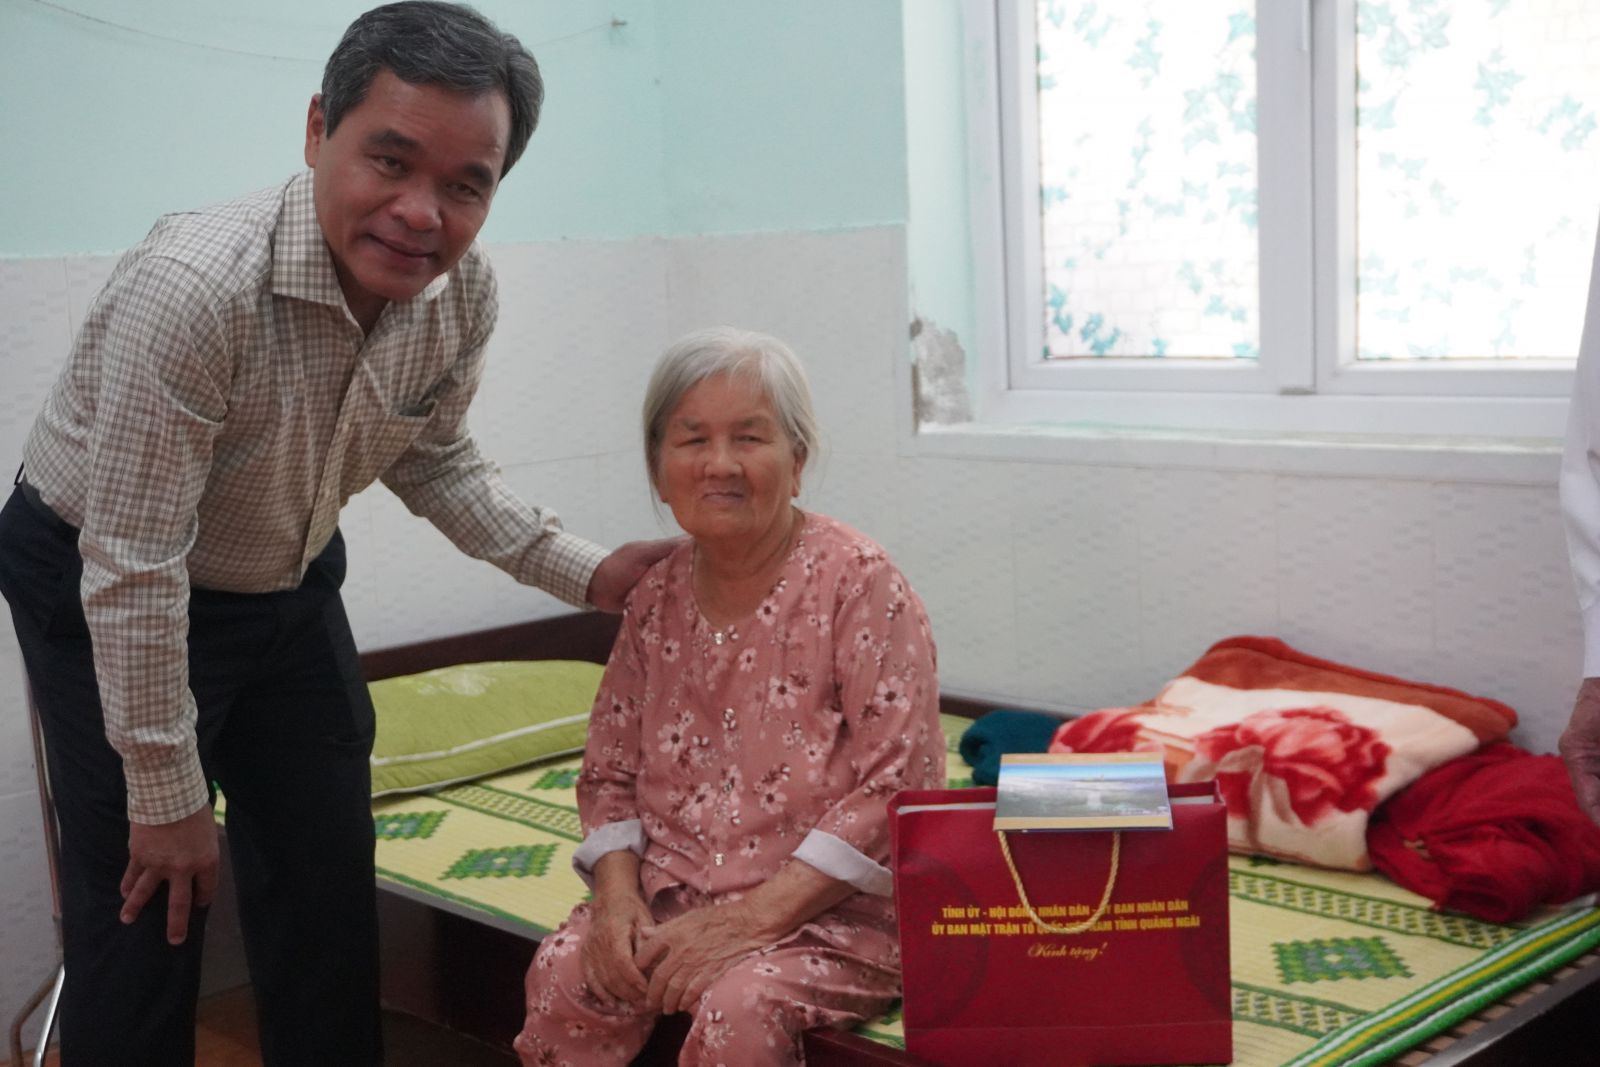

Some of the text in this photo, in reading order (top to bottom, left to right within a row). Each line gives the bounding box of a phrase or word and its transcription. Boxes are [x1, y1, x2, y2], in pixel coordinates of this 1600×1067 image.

[1038, 904, 1066, 917] NHÂN
[1068, 903, 1090, 916] DÂN
[1114, 903, 1135, 914] BAN
[1137, 900, 1165, 913] NHÂN
[1167, 899, 1188, 911] DÂN
[947, 924, 968, 935] BAN
